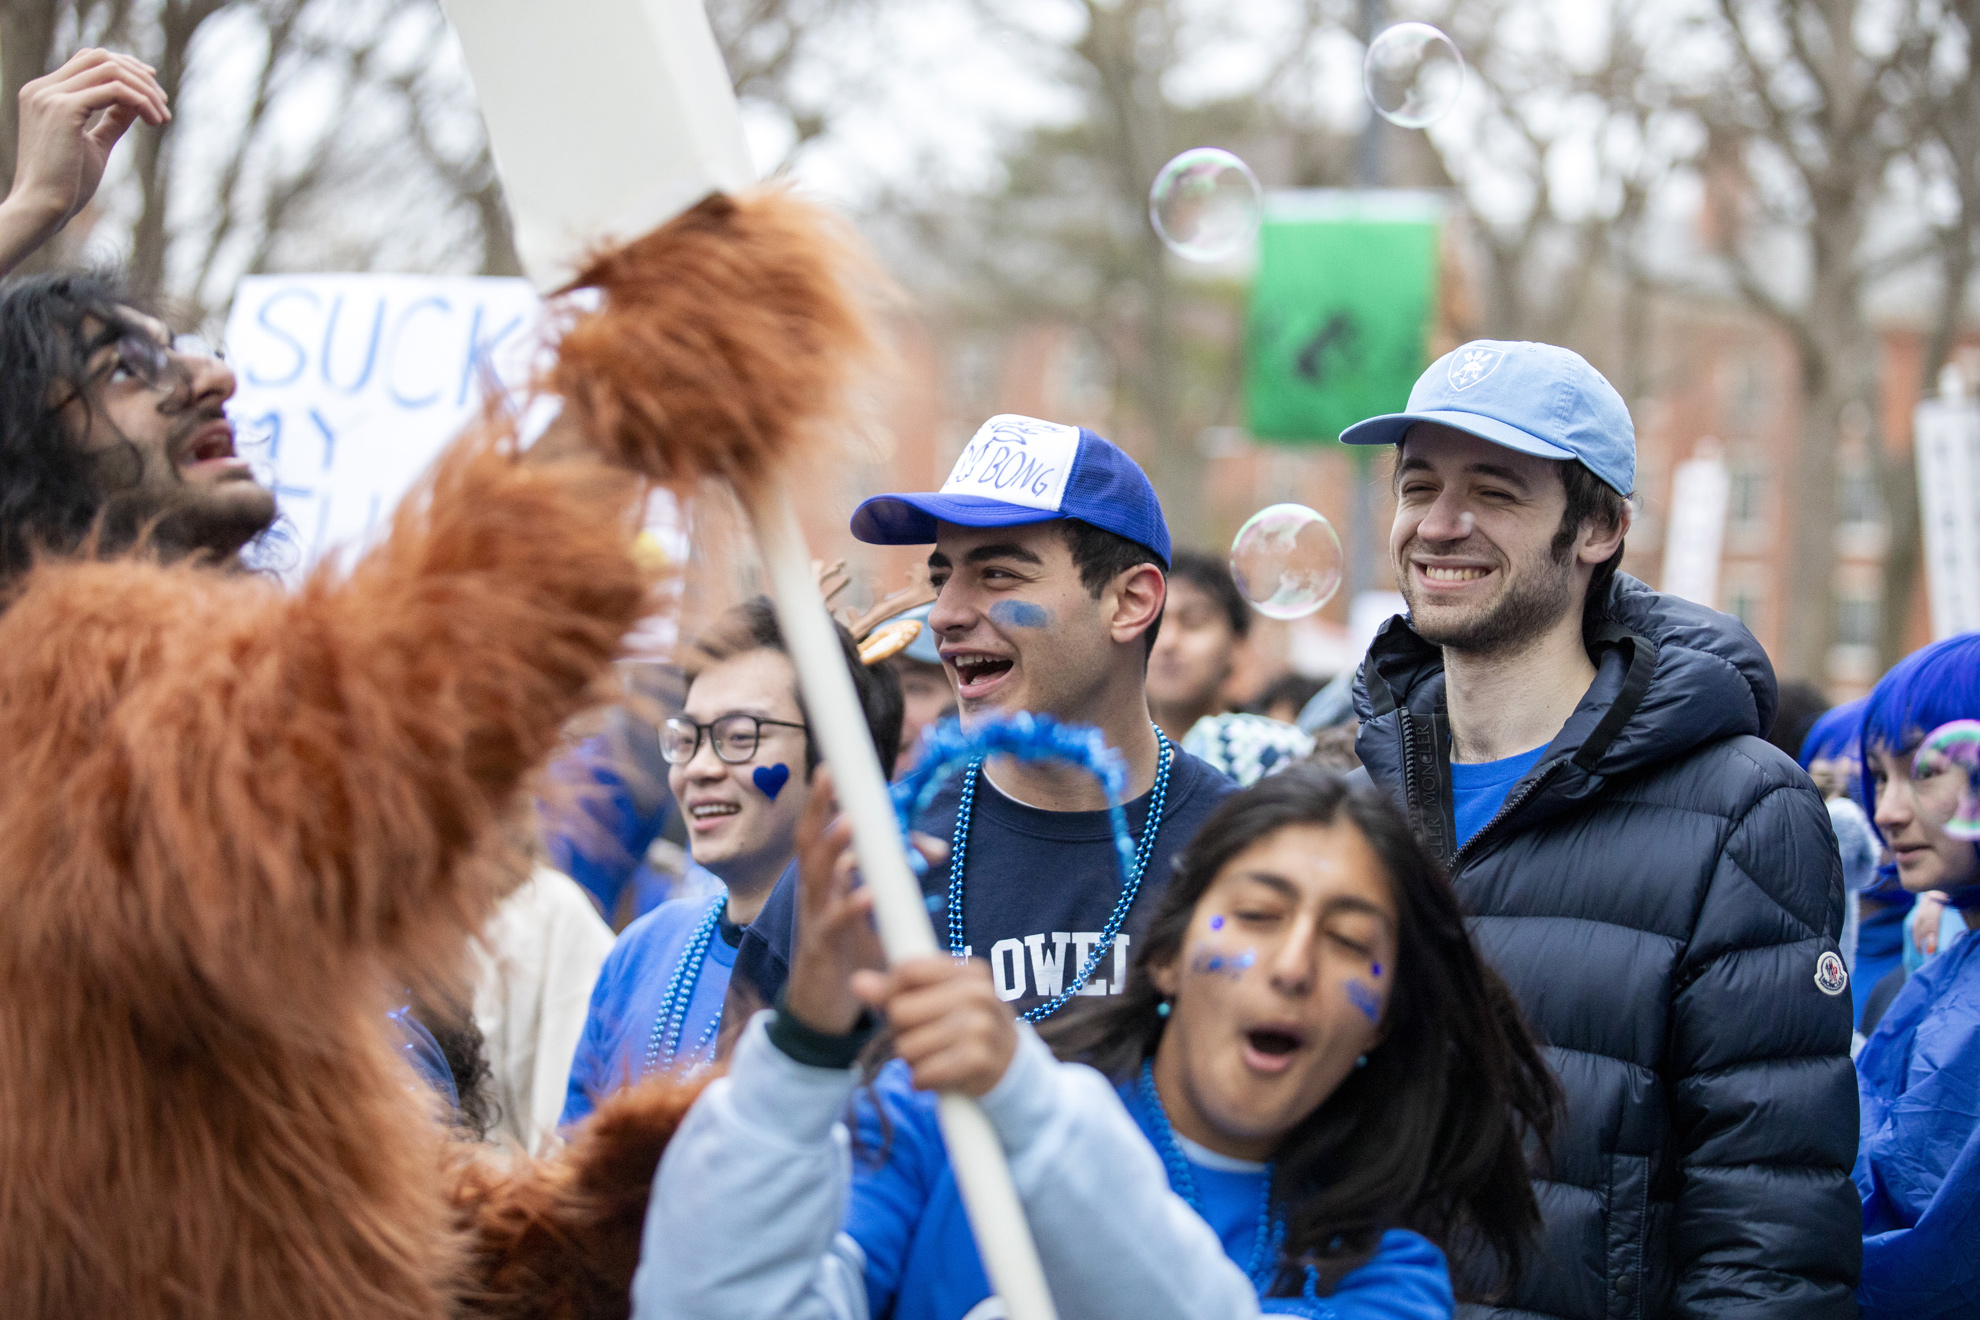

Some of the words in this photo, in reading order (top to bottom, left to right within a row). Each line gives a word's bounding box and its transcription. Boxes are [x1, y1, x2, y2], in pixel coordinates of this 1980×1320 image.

[245, 285, 524, 412] SUCK
[977, 445, 1056, 498] BONG
[1415, 723, 1437, 806] MONCLER
